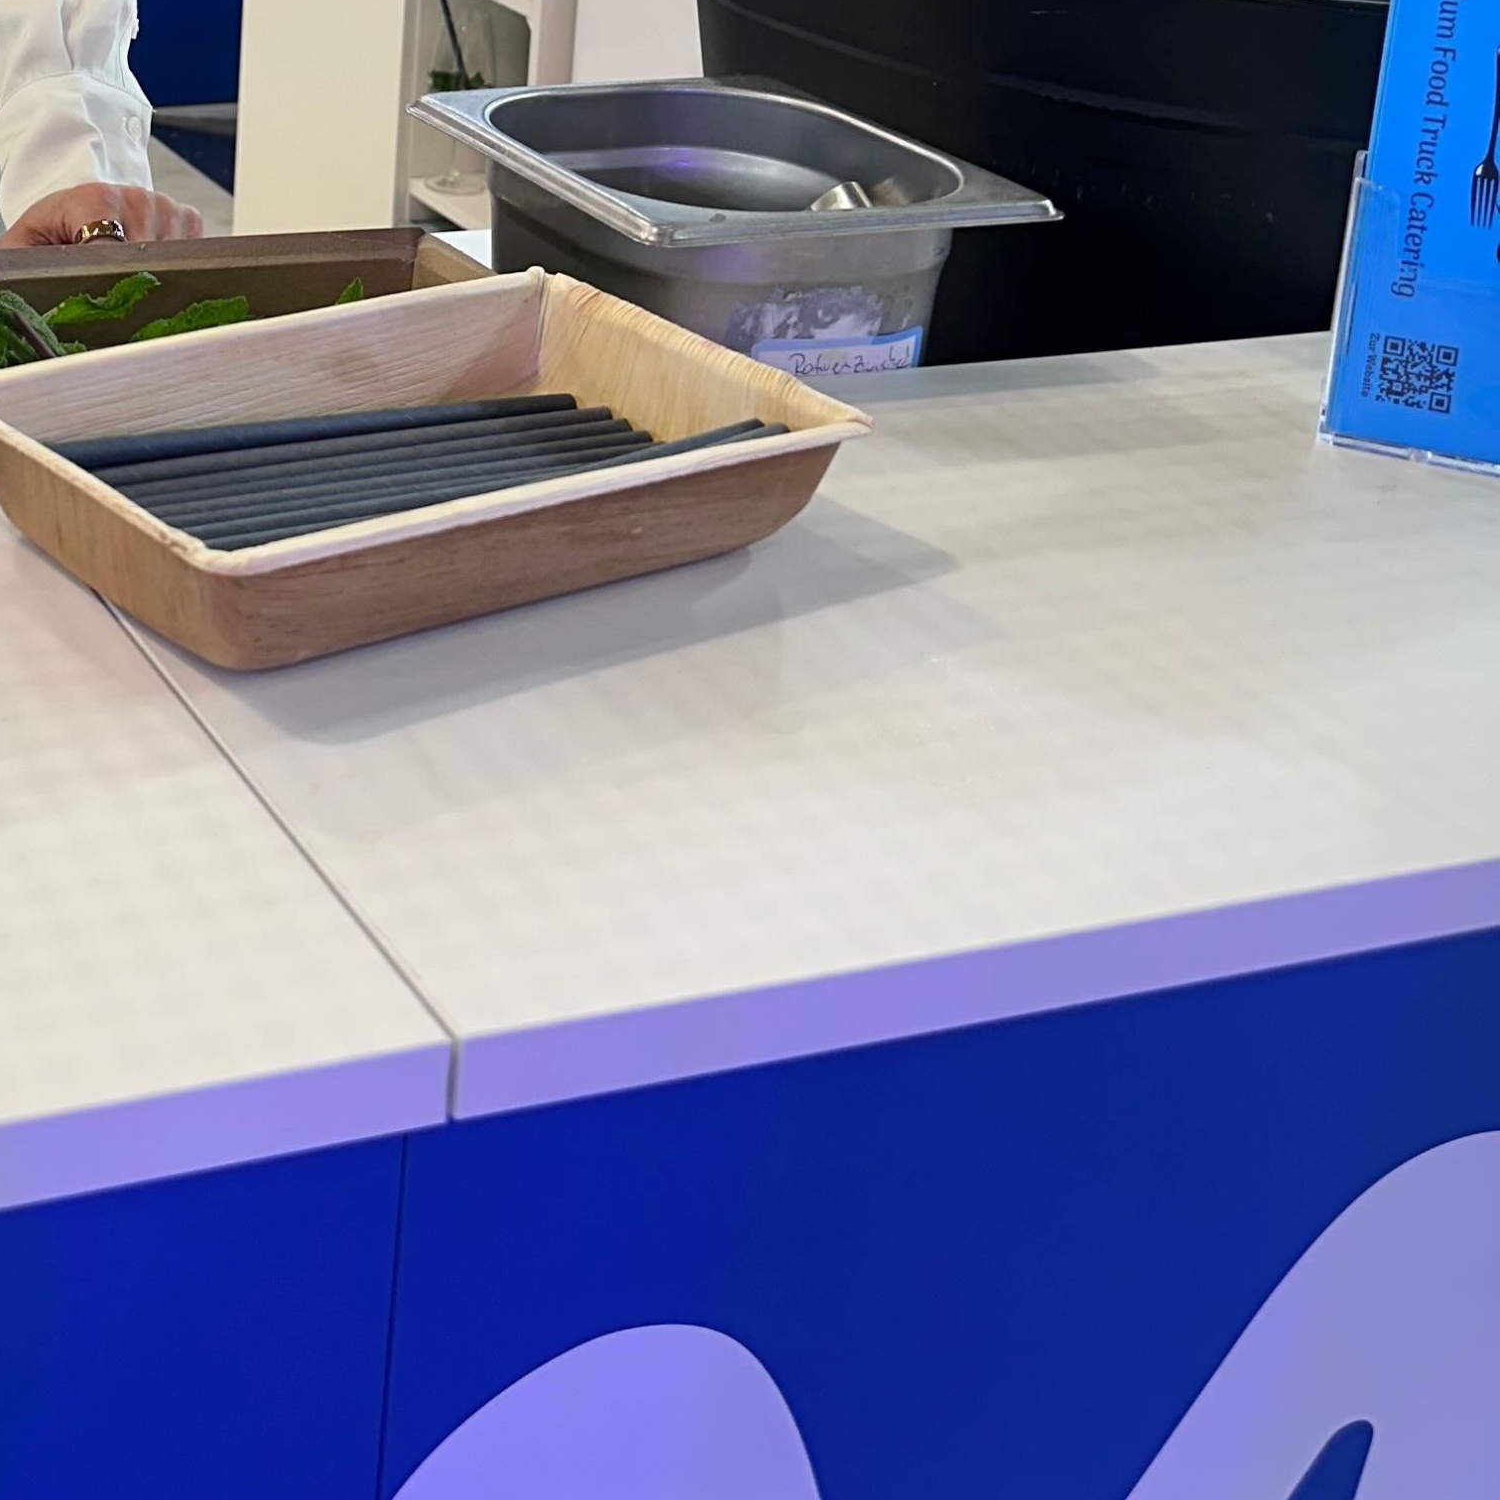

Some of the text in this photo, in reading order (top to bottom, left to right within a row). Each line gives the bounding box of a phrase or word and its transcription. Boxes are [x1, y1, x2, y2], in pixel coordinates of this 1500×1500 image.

[1425, 46, 1457, 107] Food
[1414, 114, 1446, 185] Truck
[1391, 192, 1435, 299] Catering
[1360, 354, 1377, 398] Website
